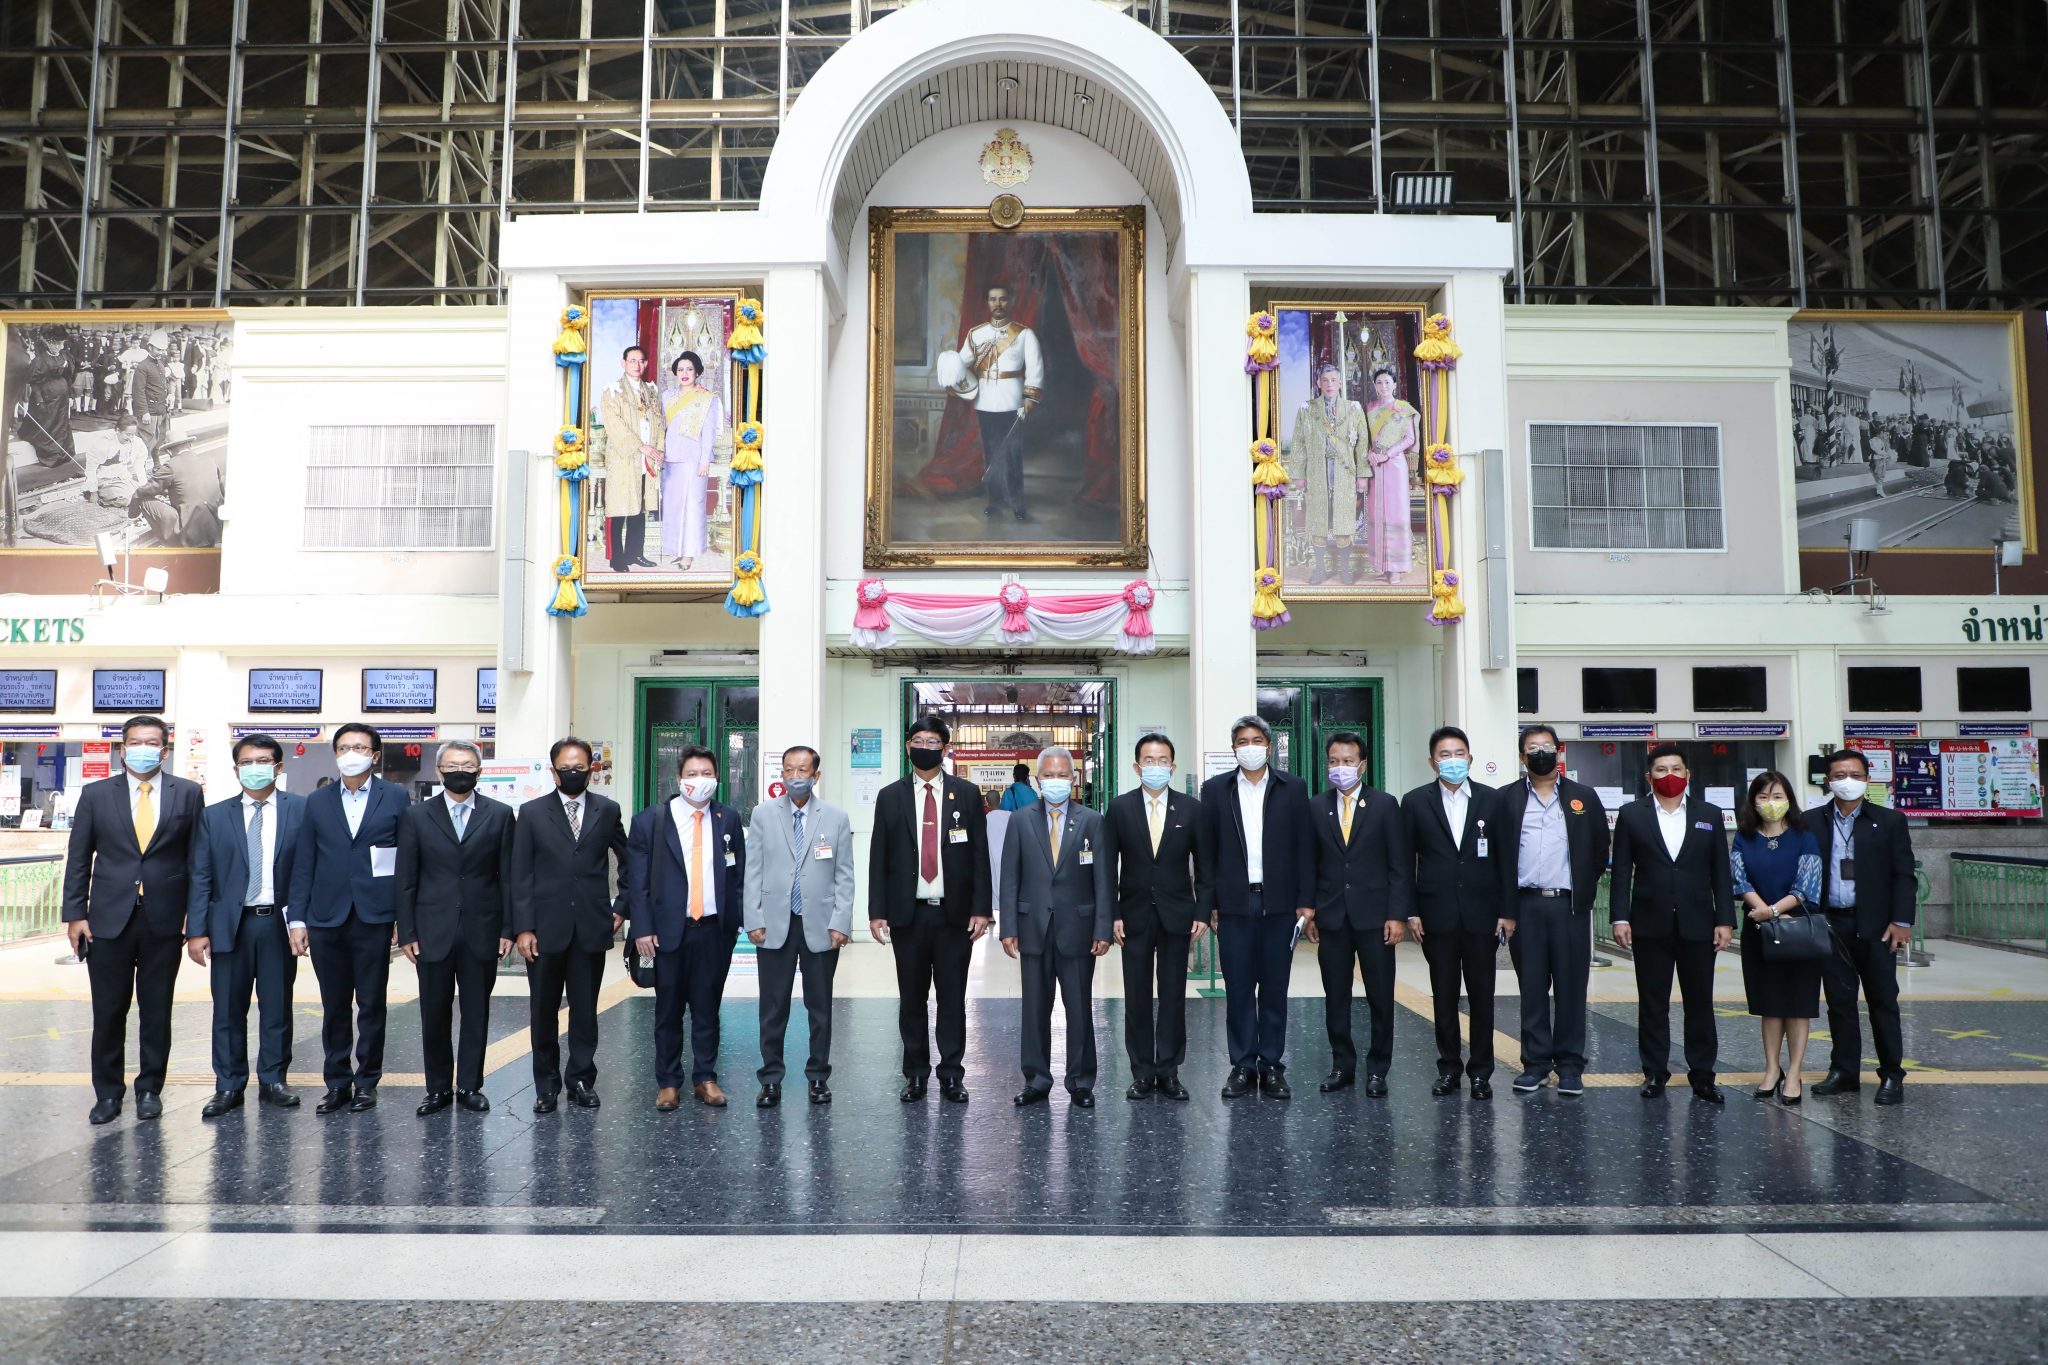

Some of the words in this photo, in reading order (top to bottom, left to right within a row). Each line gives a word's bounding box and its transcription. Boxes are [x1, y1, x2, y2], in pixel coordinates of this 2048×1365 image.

[1962, 605, 2048, 642] จำหน่
[37, 744, 47, 757] 7
[295, 743, 306, 756] 9
[404, 744, 422, 757] 10
[1600, 743, 1617, 755] 13
[1712, 743, 1728, 755] 14
